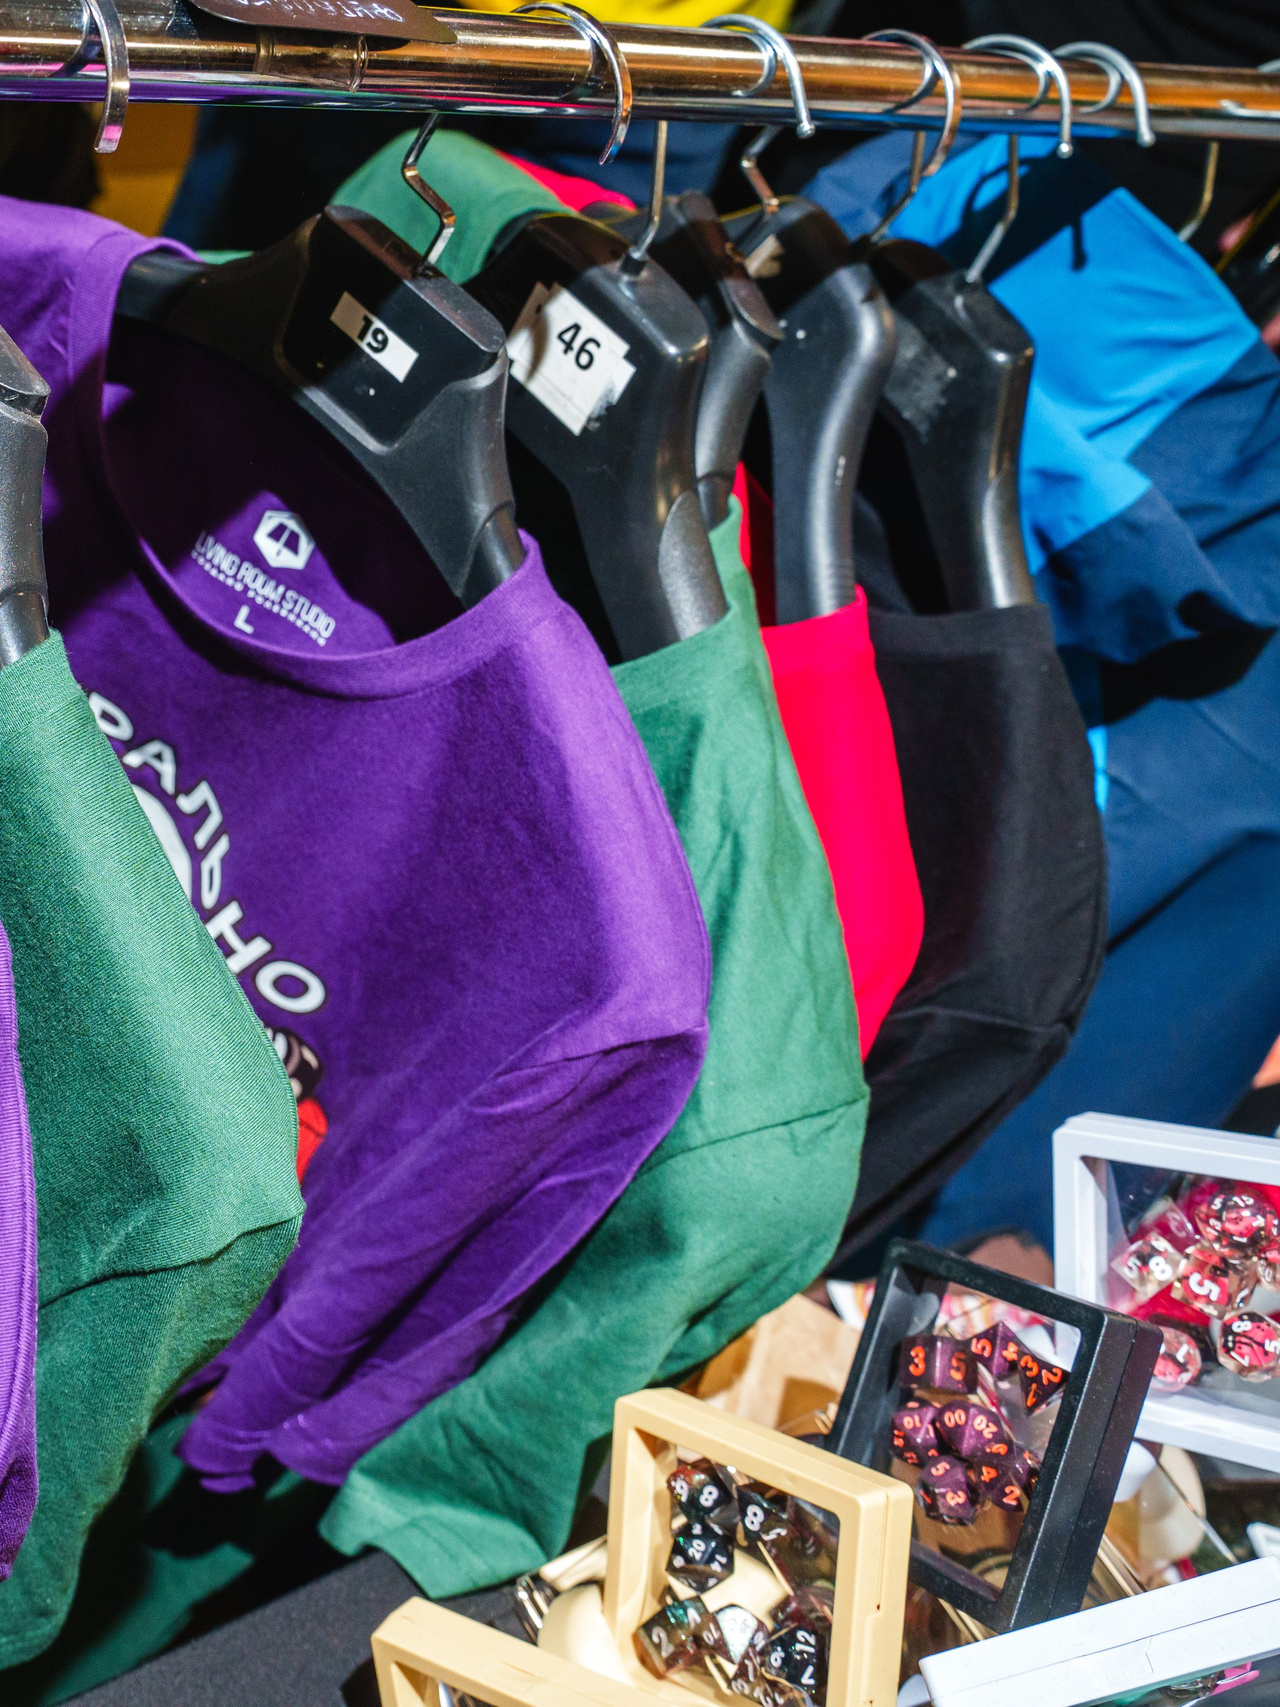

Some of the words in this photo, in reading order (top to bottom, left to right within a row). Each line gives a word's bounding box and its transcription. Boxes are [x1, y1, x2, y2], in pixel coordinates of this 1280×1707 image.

[356, 315, 389, 354] 19
[557, 322, 601, 371] 46
[195, 529, 240, 577] LIVING
[236, 561, 286, 604] ROOM
[281, 589, 336, 639] STUDIO
[233, 604, 255, 635] L
[1148, 1255, 1173, 1282] 8
[1188, 1271, 1220, 1302] 5
[971, 1337, 992, 1358] 5
[909, 1346, 926, 1376] 3
[1020, 1355, 1040, 1378] 3
[1041, 1367, 1063, 1386] 2
[943, 1408, 967, 1428] 00
[930, 1461, 951, 1477] 5
[699, 1484, 720, 1508] 8
[945, 1490, 967, 1507] 3
[1002, 1485, 1021, 1506] 2
[744, 1503, 765, 1532] 8
[688, 1538, 706, 1561] 20
[652, 1625, 675, 1658] 2
[795, 1629, 816, 1653] 12
